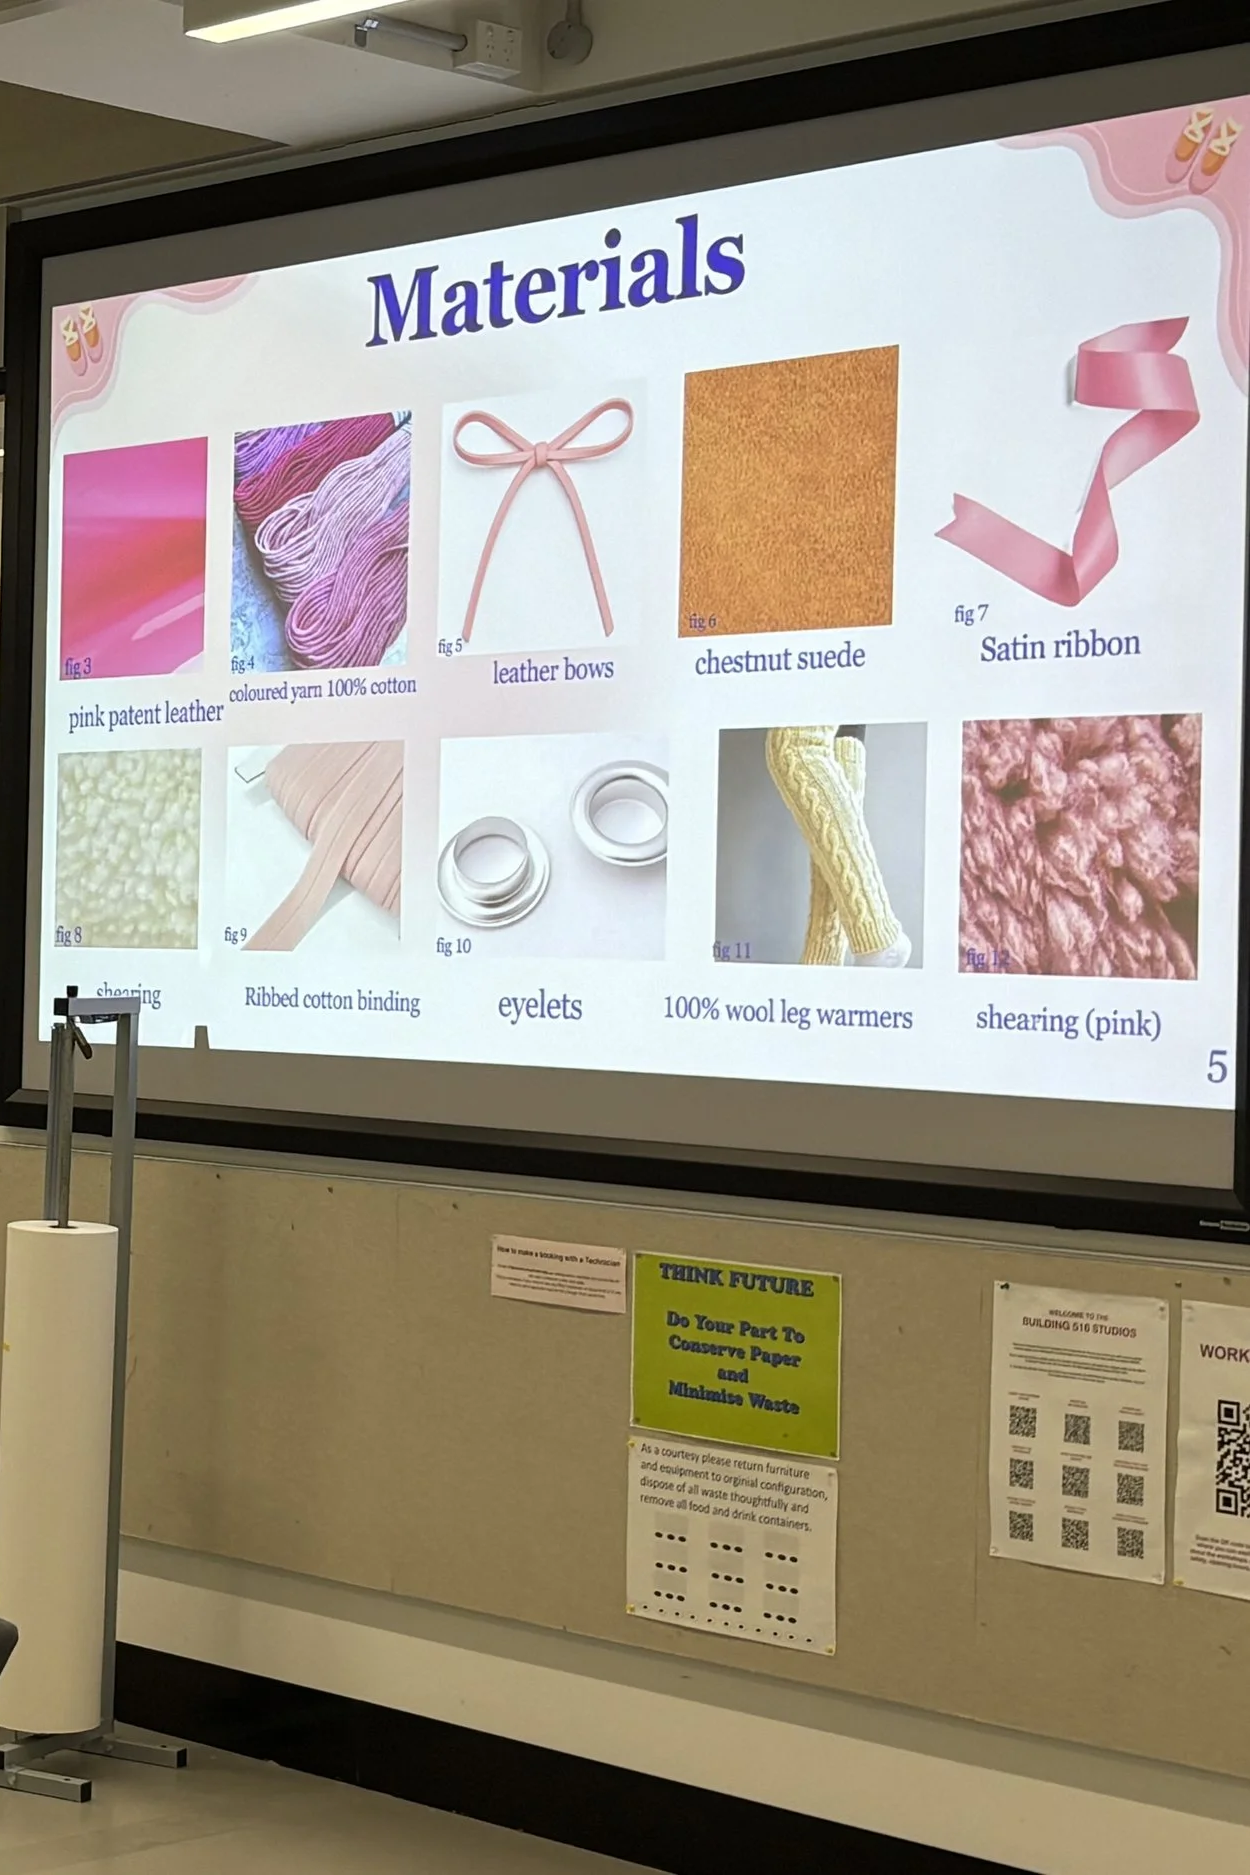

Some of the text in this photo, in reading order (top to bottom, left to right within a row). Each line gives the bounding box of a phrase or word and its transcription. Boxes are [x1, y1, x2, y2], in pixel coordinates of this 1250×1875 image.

[366, 213, 746, 347] Materials
[688, 614, 706, 631] fig
[954, 604, 989, 625] fig 7
[438, 638, 463, 657] fig 5
[695, 640, 867, 675] chestnut suede
[980, 630, 1141, 663] Satin ribbon
[65, 657, 92, 679] fig 3
[230, 655, 255, 674] fig 4
[493, 656, 614, 684] leather bows
[229, 677, 417, 704] coloured yarn 100% cotton
[68, 699, 225, 734] pink patent leather
[54, 926, 82, 946] fig 8
[224, 928, 248, 945] fig 9
[436, 938, 472, 957] fig 10
[712, 940, 750, 960] fig 11
[966, 948, 986, 968] fig
[245, 986, 421, 1018] Ribbed cotton binding
[499, 988, 583, 1026] eyelets
[664, 995, 913, 1031] 100% wool leg warmers
[976, 1004, 1163, 1042] shearing (pink)
[1206, 1049, 1229, 1084] 5
[518, 1248, 534, 1257] make
[540, 1251, 564, 1262] booking
[565, 1254, 578, 1262] with
[586, 1256, 621, 1267] Technician
[660, 1262, 815, 1298] THINK FUTURE
[667, 1310, 806, 1344] Do Your Part To
[1022, 1316, 1070, 1331] BUILDING
[1092, 1324, 1137, 1338] STUDIOS
[1048, 1309, 1084, 1320] WELCOME
[1086, 1312, 1094, 1320] TO
[669, 1335, 801, 1368] Conserve Paper
[1200, 1344, 1250, 1364] WORK
[717, 1368, 749, 1384] and
[669, 1380, 800, 1416] Minimise Waste
[641, 1443, 810, 1480] As a courtesy please return furniture
[640, 1460, 658, 1472] and
[660, 1463, 710, 1482] equipment
[710, 1471, 722, 1482] to
[760, 1480, 829, 1501] configuration,
[640, 1476, 810, 1514] dispose of all waste thoughtfully and
[640, 1494, 812, 1532] remove all food and drink containers.
